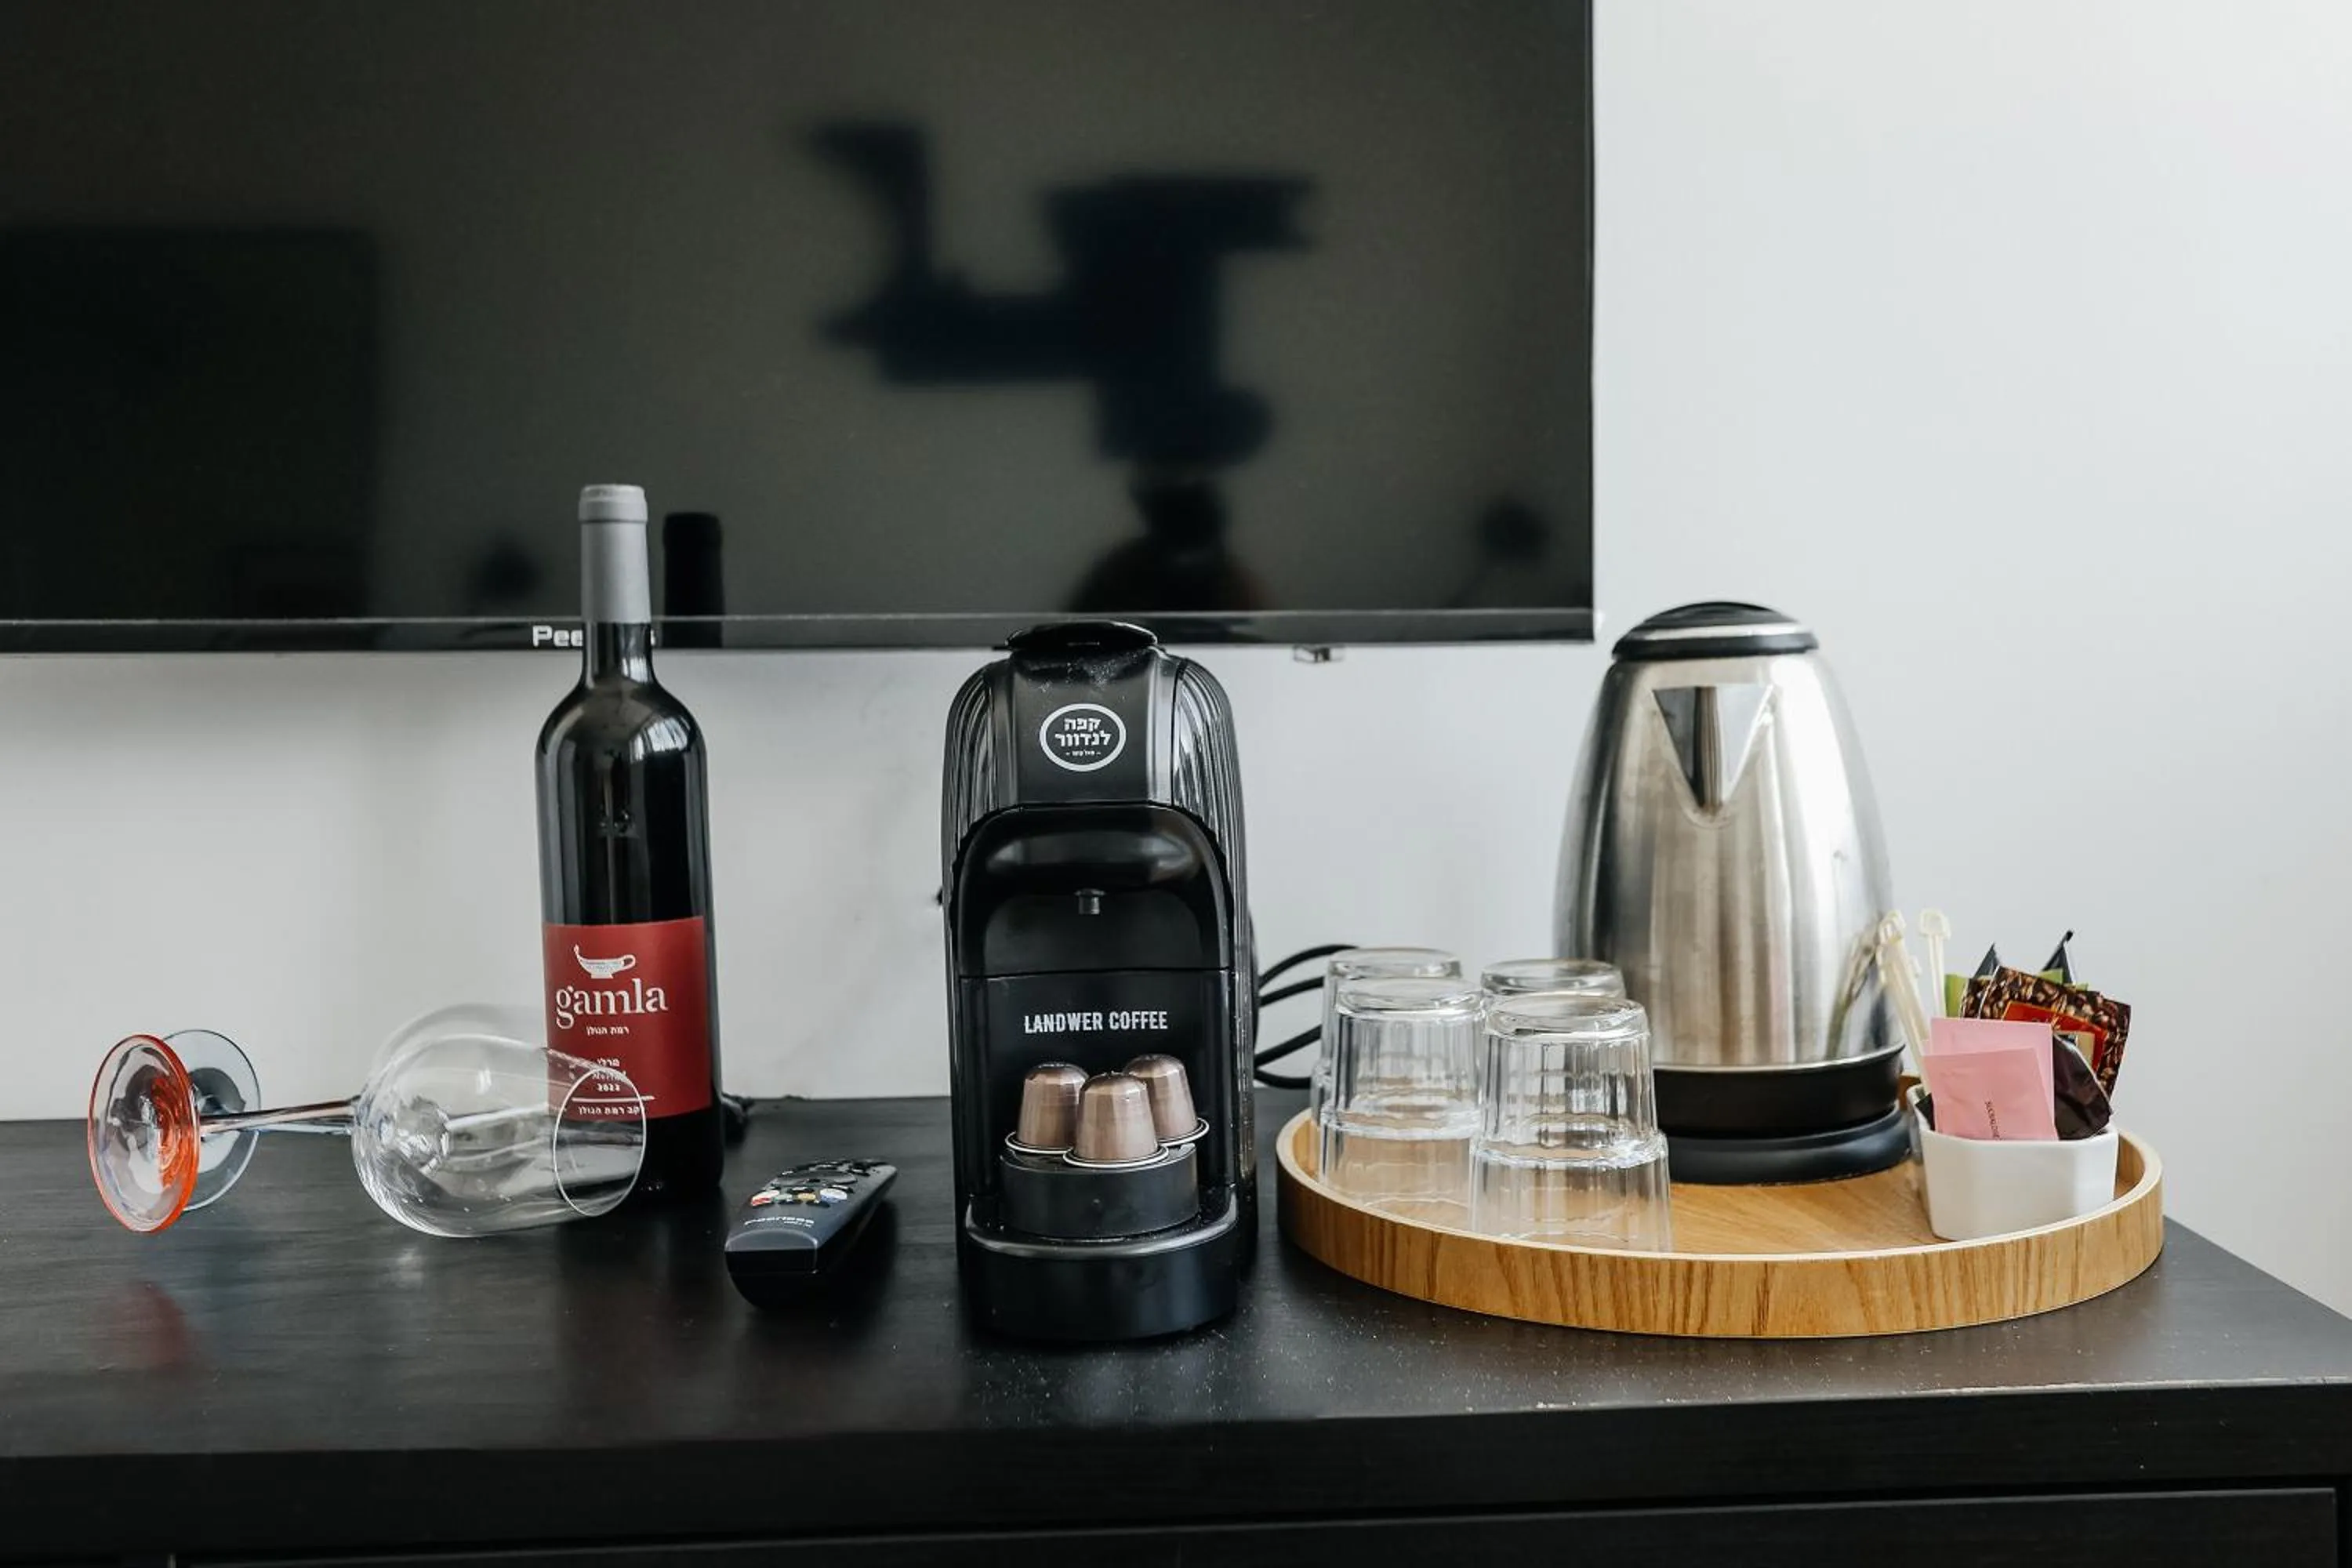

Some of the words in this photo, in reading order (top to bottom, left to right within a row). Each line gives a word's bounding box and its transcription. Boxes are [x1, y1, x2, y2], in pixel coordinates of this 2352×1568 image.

[532, 625, 583, 647] Pee
[1064, 717, 1102, 731] קפה
[1054, 730, 1112, 747] לנדוור
[556, 977, 669, 1029] gamla
[1025, 1012, 1103, 1034] LANDWER
[1109, 1011, 1168, 1030] COFFEE
[578, 1105, 602, 1115] הגולן
[604, 1105, 625, 1115] רמת
[626, 1105, 642, 1115] קב
